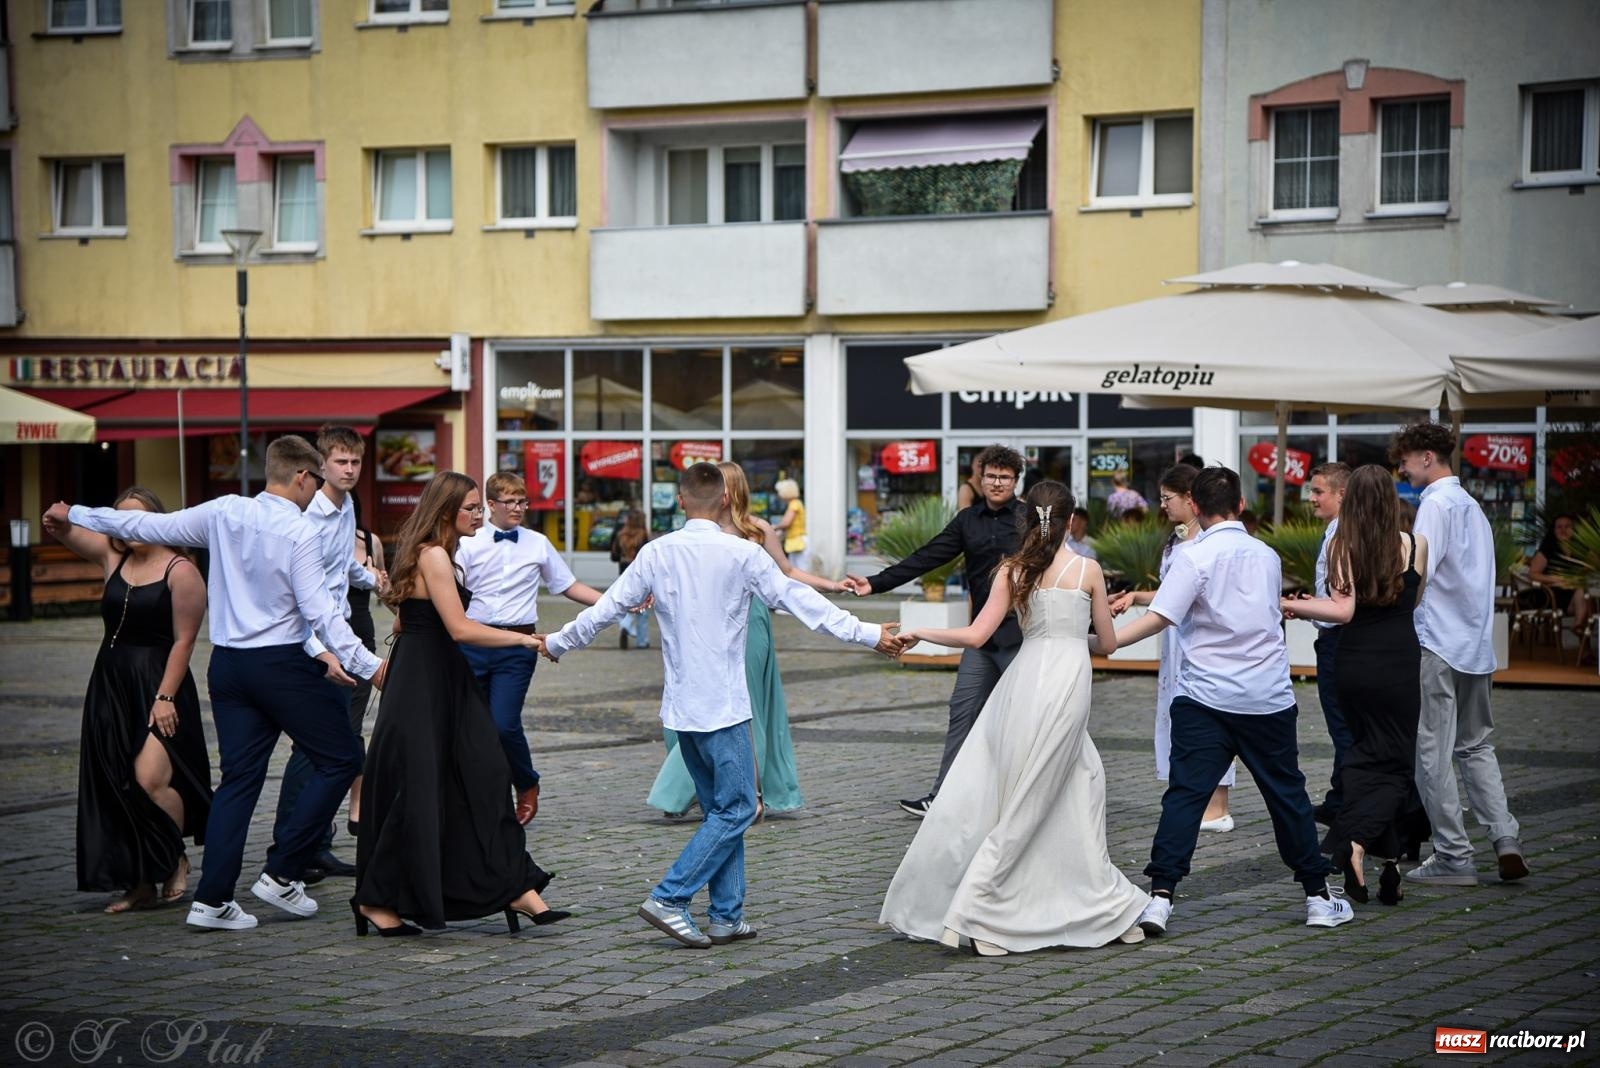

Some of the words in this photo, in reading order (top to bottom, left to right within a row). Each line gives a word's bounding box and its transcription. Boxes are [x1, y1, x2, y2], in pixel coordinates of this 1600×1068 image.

[1101, 363, 1215, 390] gelatopiu
[500, 381, 563, 400] empik.com
[898, 450, 918, 467] 35
[1091, 455, 1129, 470] -35%
[1480, 444, 1528, 465] -70%
